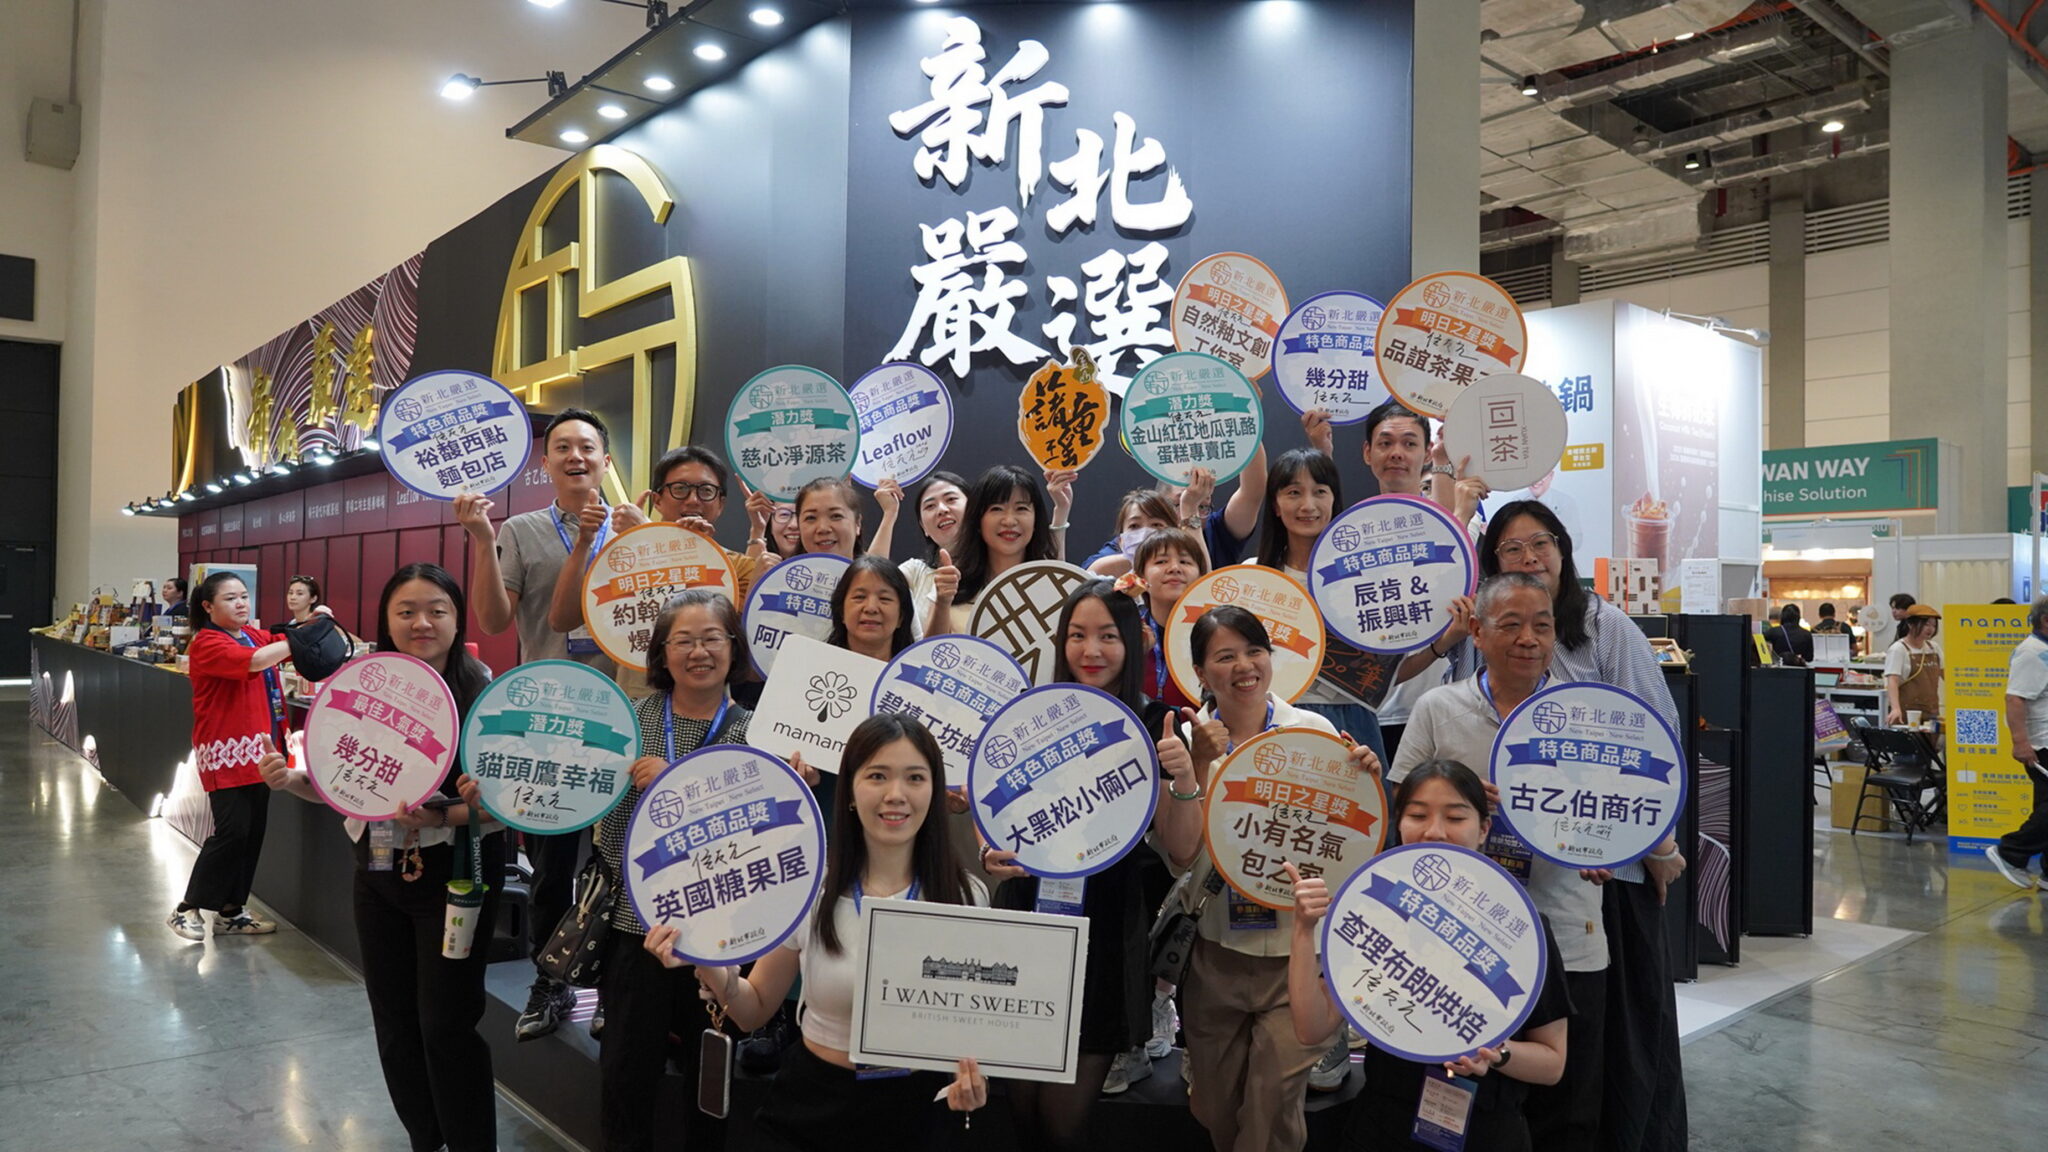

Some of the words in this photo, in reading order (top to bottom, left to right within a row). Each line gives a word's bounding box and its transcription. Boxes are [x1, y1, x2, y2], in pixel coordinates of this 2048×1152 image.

[889, 16, 1193, 232] 新北
[882, 206, 1178, 398] 嚴選
[1208, 287, 1268, 323] 明日之星獎
[1182, 305, 1271, 359] 自然釉文創
[1305, 335, 1375, 351] 特色商品獎
[1420, 311, 1498, 351] 明日之星獎
[1190, 336, 1245, 370] 工作室
[420, 378, 478, 404] 新北嚴選
[1305, 367, 1369, 391] 幾分甜
[1542, 375, 1594, 413] 鍋
[410, 402, 489, 438] 特色商品獎
[771, 409, 815, 425] 潛力獎
[860, 393, 921, 429] 特色商品獎
[1168, 393, 1214, 411] 潛力獎
[414, 424, 508, 470] 裕馥西點
[862, 423, 932, 466] Leaflow
[1130, 415, 1257, 445] 金山紅紅地瓜乳酪
[436, 450, 507, 489] 麵包店
[741, 442, 847, 469] 慈心淨源茶
[1157, 440, 1236, 465] 蛋糕專賣店
[1815, 457, 1870, 478] WAY
[524, 466, 552, 486] 古乙伯
[1763, 490, 1794, 503] hise
[1799, 487, 1868, 502] Solution
[1361, 513, 1424, 534] 新北嚴選
[637, 537, 698, 557] 新北嚴選
[1344, 543, 1430, 572] 特色商品獎
[617, 566, 701, 593] 明日之星獎
[1242, 583, 1303, 611] 新北嚴選
[1354, 578, 1402, 607] 辰肯
[1410, 575, 1429, 596] &
[612, 596, 674, 627] 約翰
[1357, 600, 1433, 633] 振興軒
[753, 624, 793, 650] 阿
[389, 674, 444, 710] 新北嚴選
[961, 655, 1023, 693] 新北嚴選
[541, 681, 611, 704] 新北嚴選
[924, 669, 1003, 718] 特色商品獎
[351, 695, 428, 744] 最佳人氣獎
[528, 713, 585, 738] 潛力獎
[1012, 694, 1081, 742] 新北嚴選
[1570, 706, 1646, 729] 新北嚴選
[333, 733, 404, 785] 幾分甜
[1005, 727, 1100, 791] 特色商品獎
[1290, 751, 1360, 780] 新北嚴選
[1539, 739, 1642, 769] 特色商品獎
[475, 751, 617, 795] 貓頭鷹幸福
[683, 759, 760, 800] 新北嚴選
[1006, 758, 1148, 853] 大黑松小倆口
[1254, 780, 1351, 818] 明日之星獎
[1510, 783, 1662, 826] 古乙伯商行
[664, 802, 771, 856] 特色商品獎
[1233, 813, 1347, 862] 小有名氣
[652, 845, 810, 925] 英國糖果屋
[1452, 875, 1529, 938] 新北嚴選
[1399, 888, 1500, 976] 特色商品獎
[1334, 910, 1489, 1044] 查理布朗烘焙
[896, 987, 964, 1008] WANT
[970, 994, 1056, 1017] SWEETS
[912, 1011, 949, 1022] BRITISH
[952, 1015, 984, 1026] SWEET
[988, 1019, 1021, 1030] HOUSE
